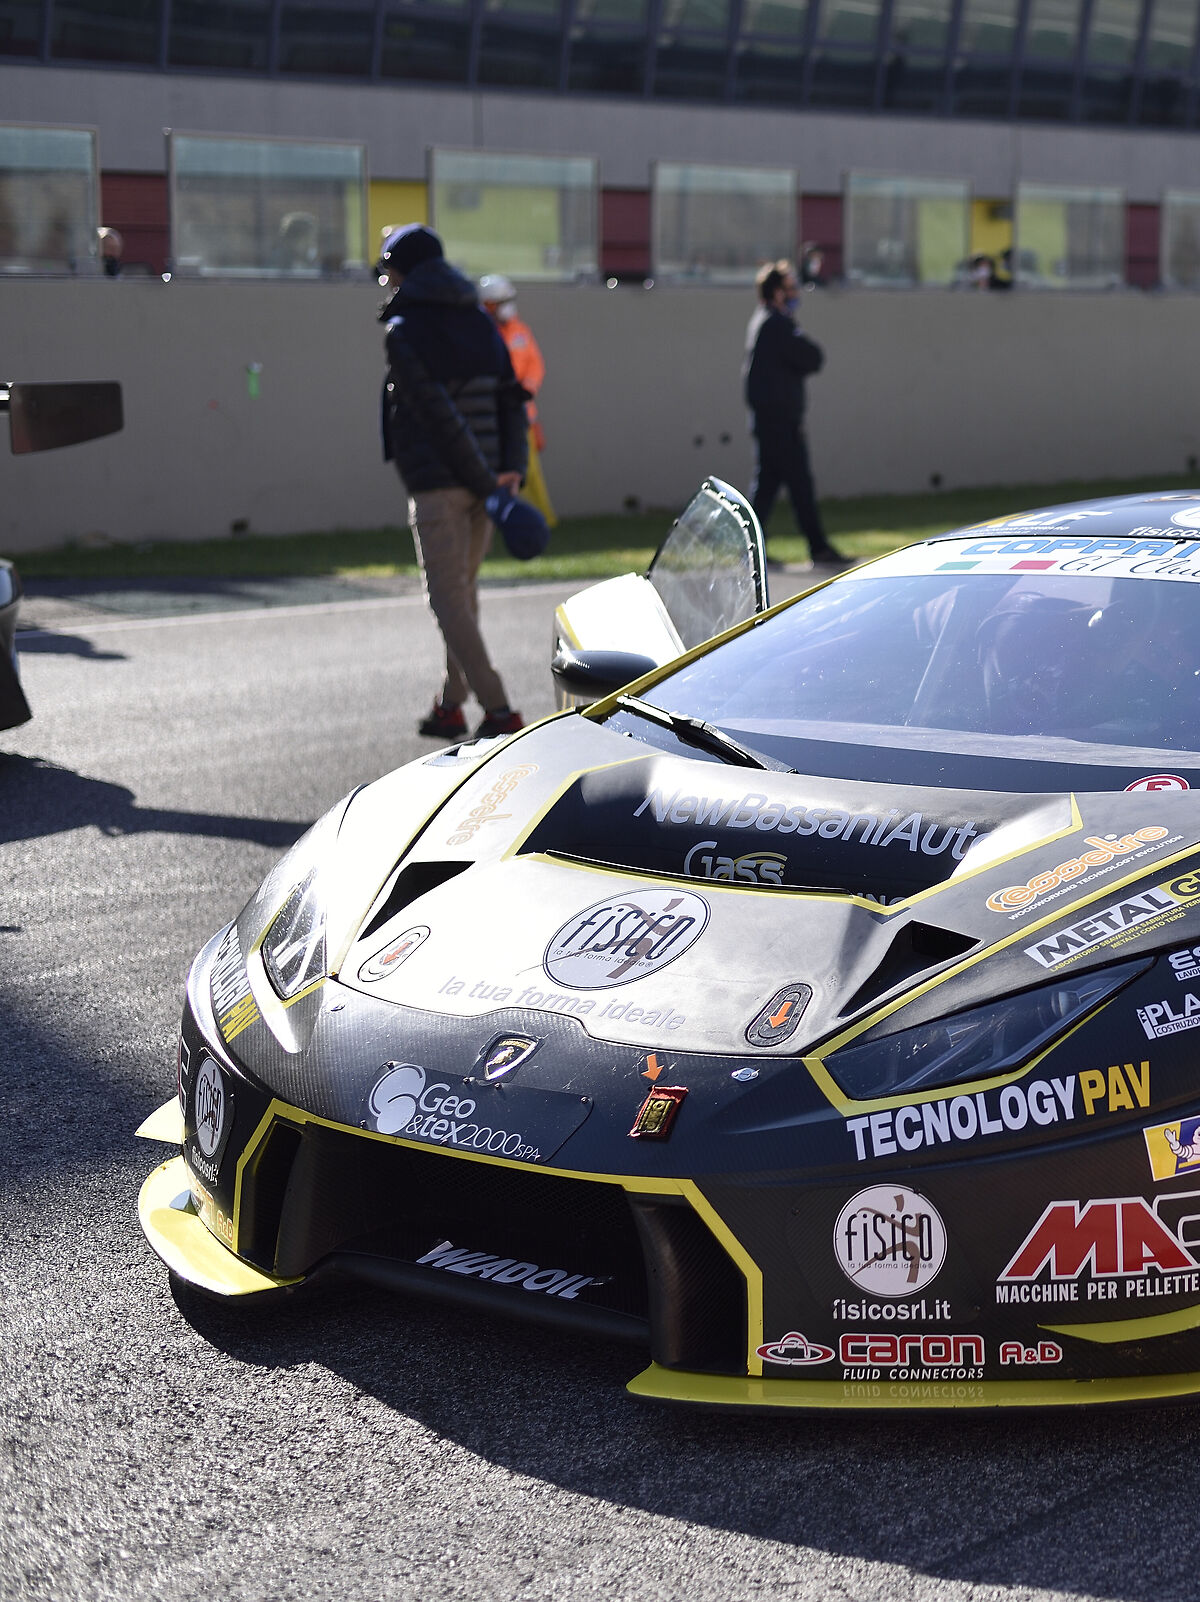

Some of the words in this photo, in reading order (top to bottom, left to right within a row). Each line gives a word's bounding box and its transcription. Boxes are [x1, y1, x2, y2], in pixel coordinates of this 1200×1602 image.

[1059, 556, 1136, 572] GT
[446, 764, 539, 845] essetre
[985, 826, 1169, 912] essetre
[1008, 884, 1078, 921] WOODWORKING
[1076, 855, 1135, 887] TECHNOLOGY
[1133, 834, 1185, 860] EVOLUTION
[560, 906, 697, 960] fisico
[1034, 892, 1175, 965] METAL
[1050, 945, 1101, 972] LABORATORIO
[1100, 926, 1143, 947] SBAVATURA
[1141, 907, 1183, 929] SABBIATURA
[1111, 932, 1142, 950] METALLI
[1140, 920, 1165, 936] CONTO
[1164, 912, 1187, 925] TERZI
[553, 948, 563, 956] la
[583, 951, 613, 963] forma
[437, 975, 461, 996] la
[468, 980, 514, 1002] tua
[515, 985, 598, 1015] forma
[598, 998, 687, 1030] ideale
[419, 1083, 477, 1118] Geo
[845, 1213, 933, 1262] fisico
[415, 1240, 595, 1299] WLADOIL
[996, 1281, 1079, 1304] MACCHINE
[1087, 1281, 1118, 1301] PER
[833, 1299, 952, 1320] fisicosrl.it
[839, 1333, 986, 1367] caron
[999, 1341, 1063, 1365] A&D
[843, 1368, 881, 1381] FLUID
[889, 1368, 984, 1380] CONNECTORS
